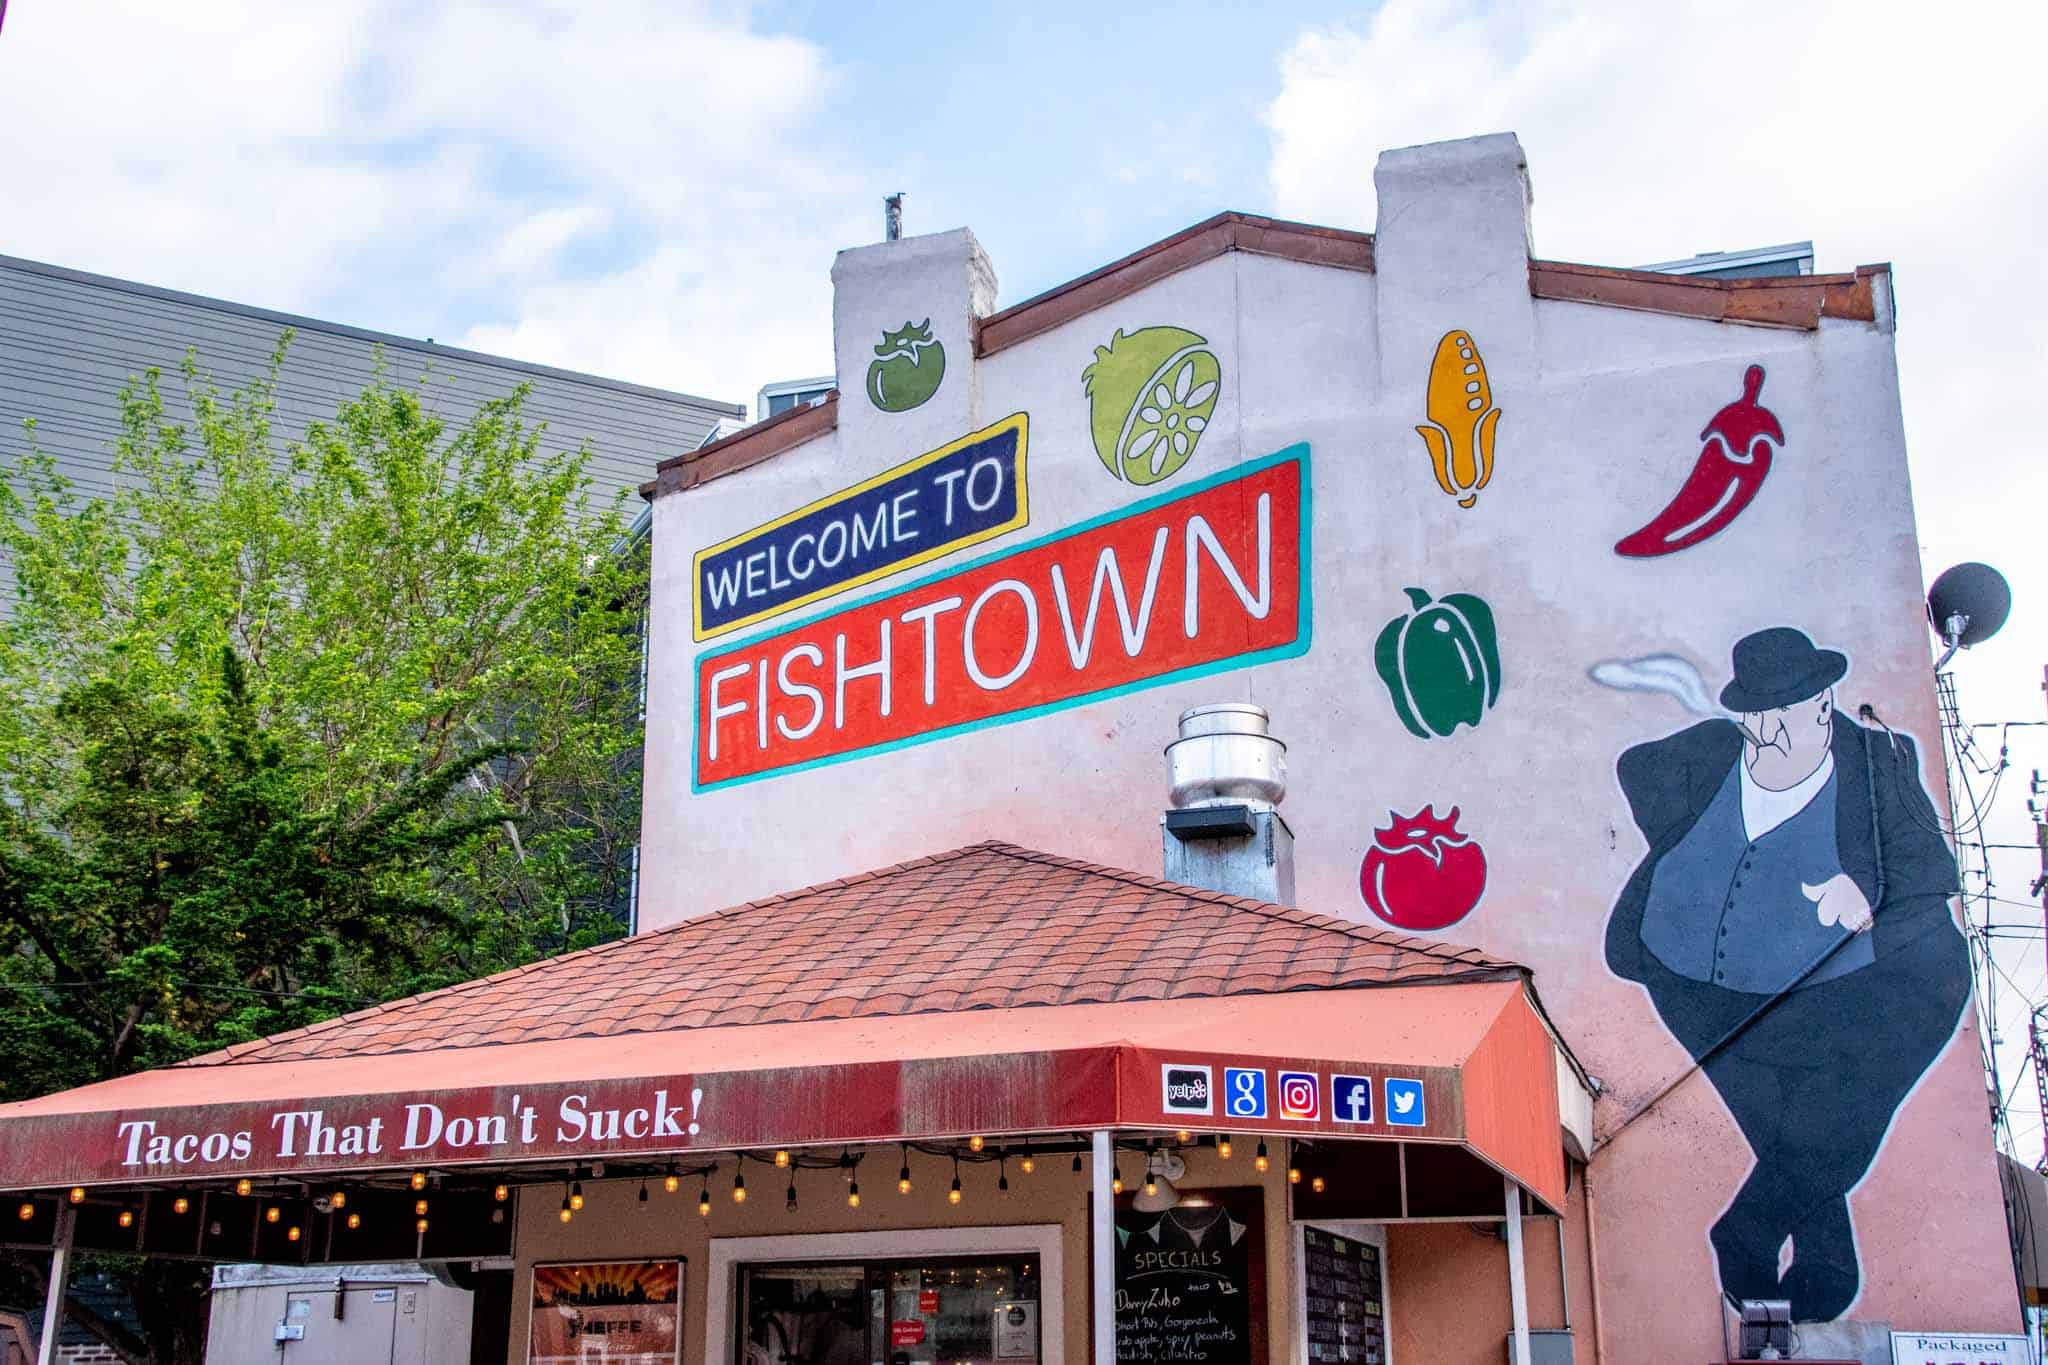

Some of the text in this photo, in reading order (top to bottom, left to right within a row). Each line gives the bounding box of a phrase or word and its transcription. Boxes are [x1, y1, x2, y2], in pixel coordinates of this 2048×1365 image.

[707, 457, 1003, 611] WELCOME TO
[706, 491, 1272, 762] FISHTOWN
[1168, 1083, 1198, 1100] yelp
[118, 1087, 703, 1166] Tacos That Don't Suck!
[1134, 1250, 1222, 1269] SPECIALS
[1916, 1338, 2008, 1354] Packaged
